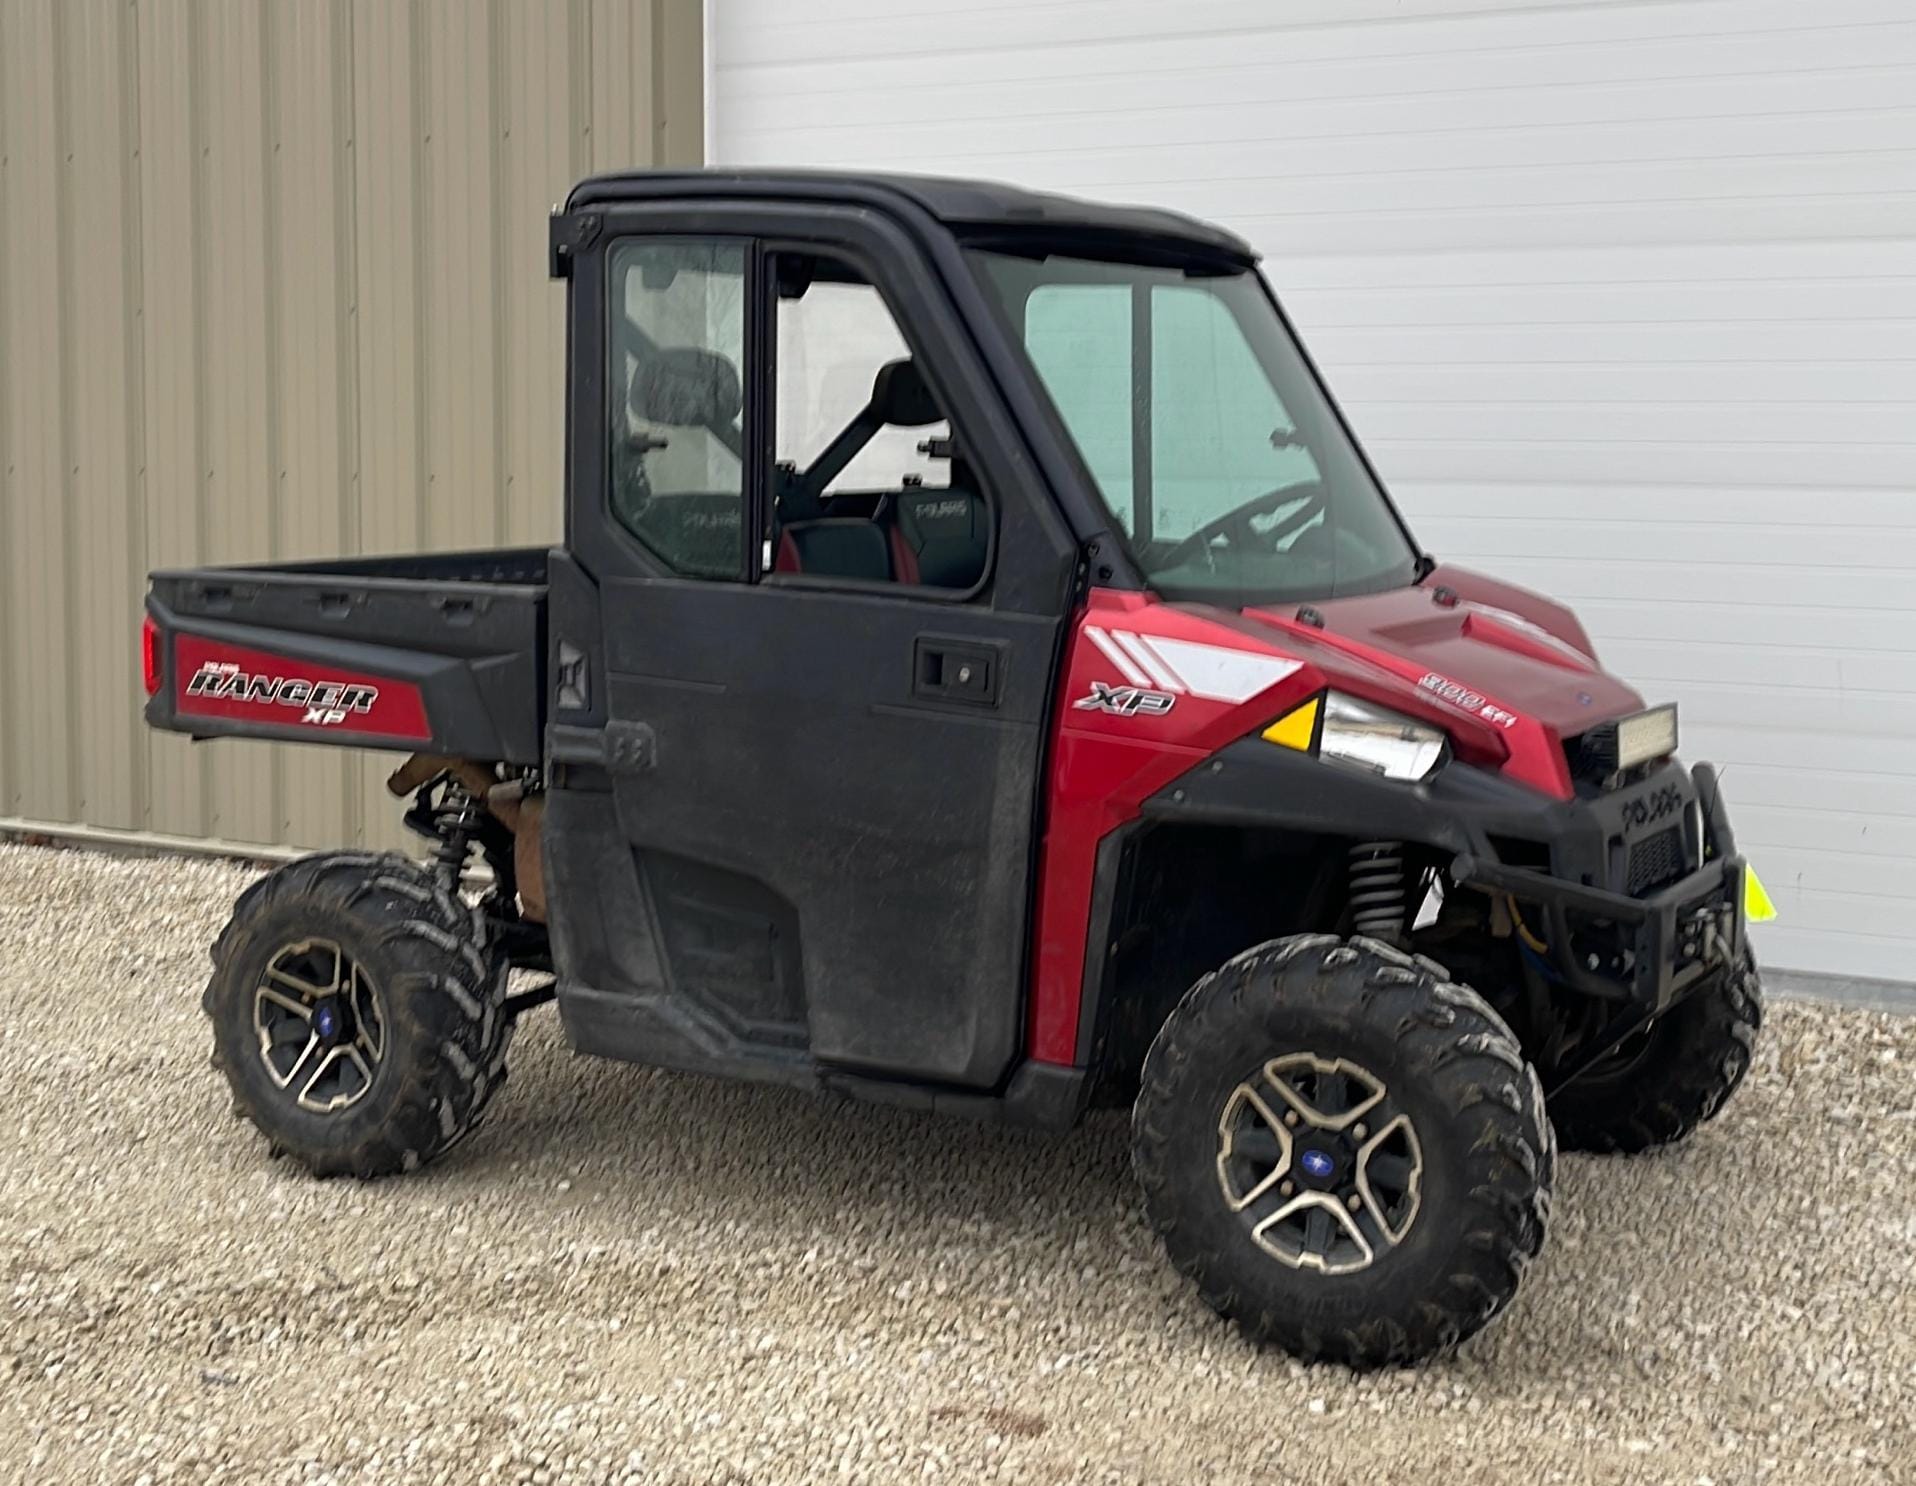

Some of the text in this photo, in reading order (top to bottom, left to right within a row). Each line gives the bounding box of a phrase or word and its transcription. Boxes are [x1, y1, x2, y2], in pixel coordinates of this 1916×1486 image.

[186, 669, 379, 715] RANGER
[1073, 680, 1176, 717] XP
[301, 708, 347, 725] XP
